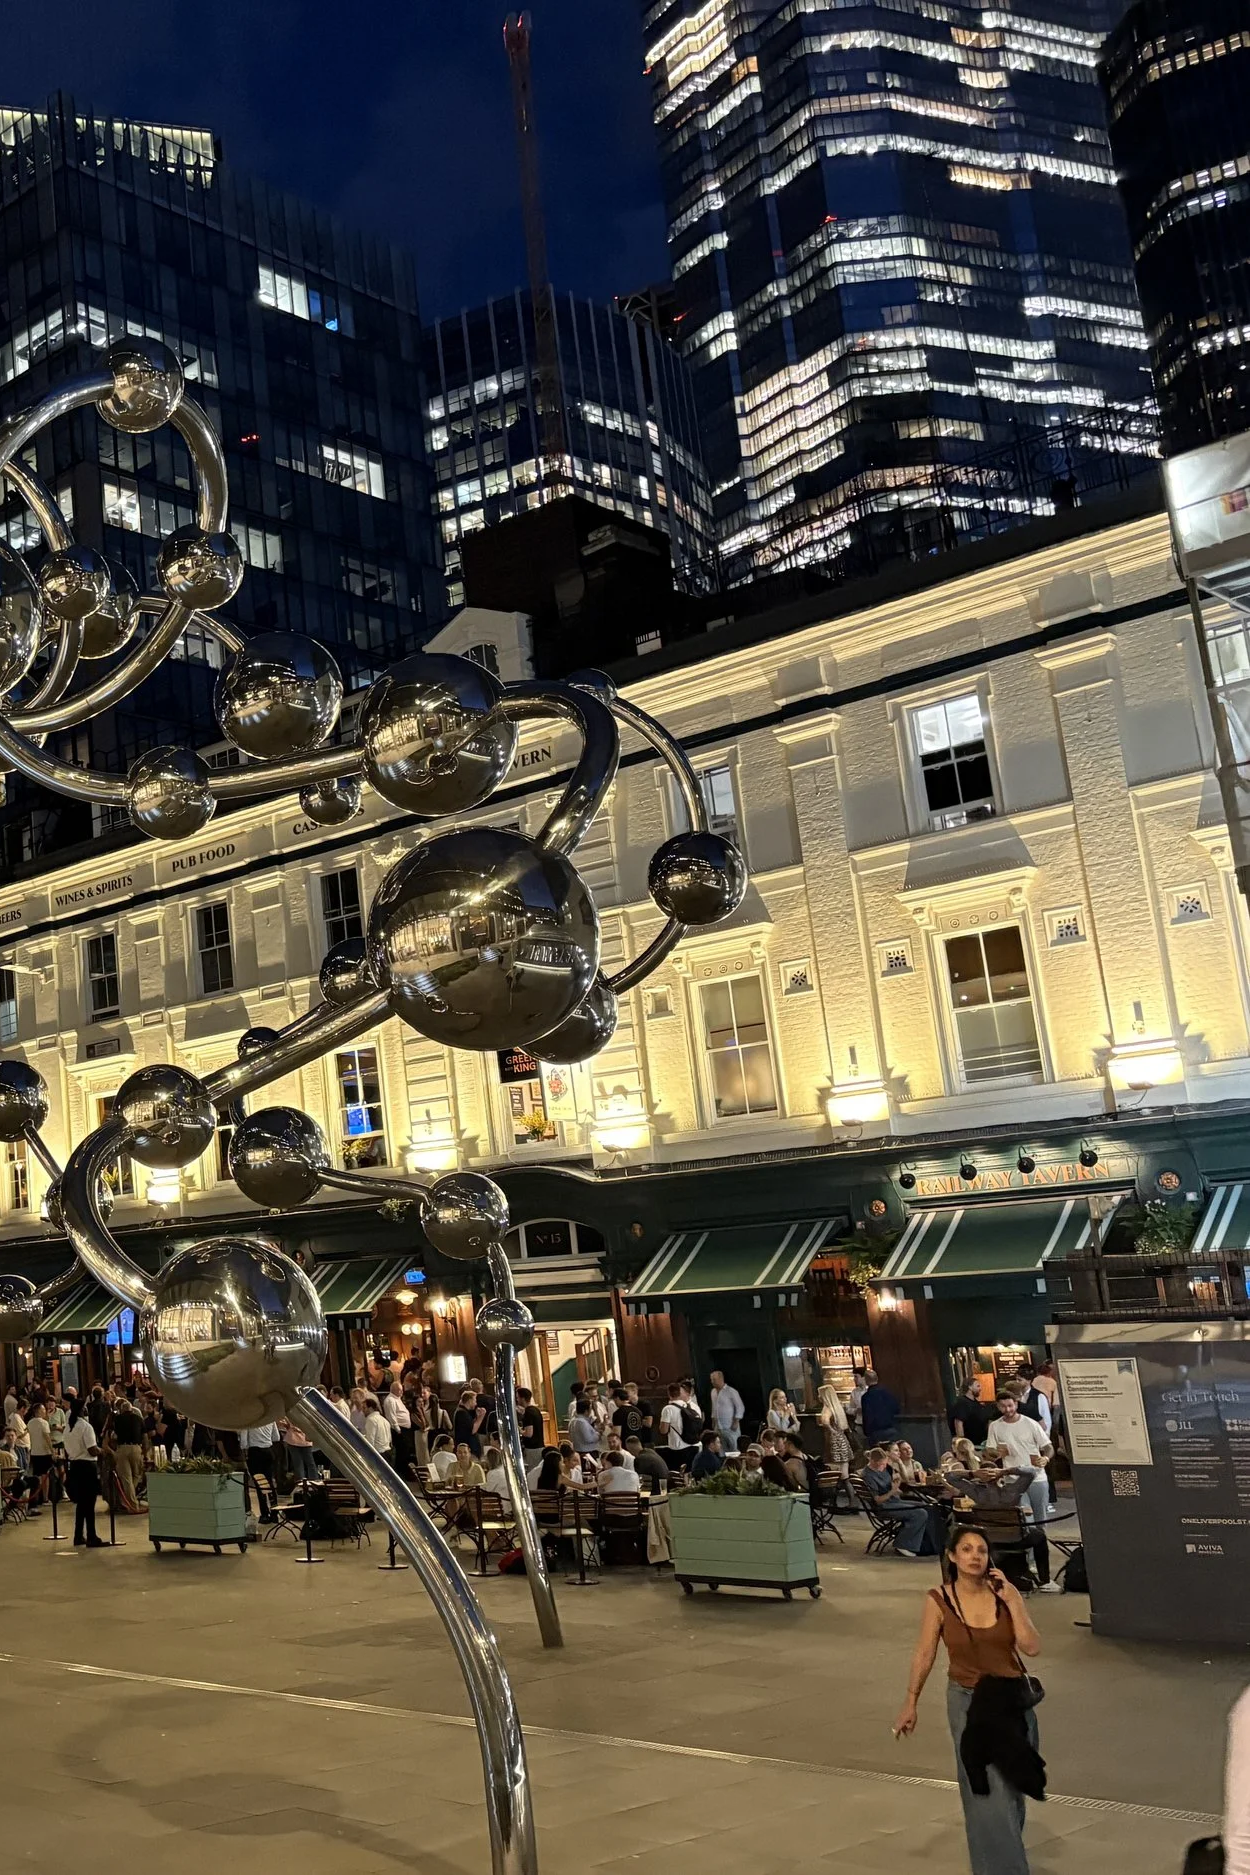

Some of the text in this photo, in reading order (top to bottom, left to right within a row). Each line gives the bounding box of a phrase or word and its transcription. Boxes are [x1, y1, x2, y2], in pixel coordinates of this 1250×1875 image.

[511, 746, 552, 770] VERN
[293, 820, 324, 836] CAS
[172, 843, 236, 872] PUB FOOD
[55, 874, 133, 907] WINES & SPIRITS
[513, 1061, 537, 1073] KING
[916, 1158, 1111, 1196] RAILWAY TAVERN
[1161, 1390, 1239, 1402] Get In Touch
[1178, 1421, 1194, 1430] JLL
